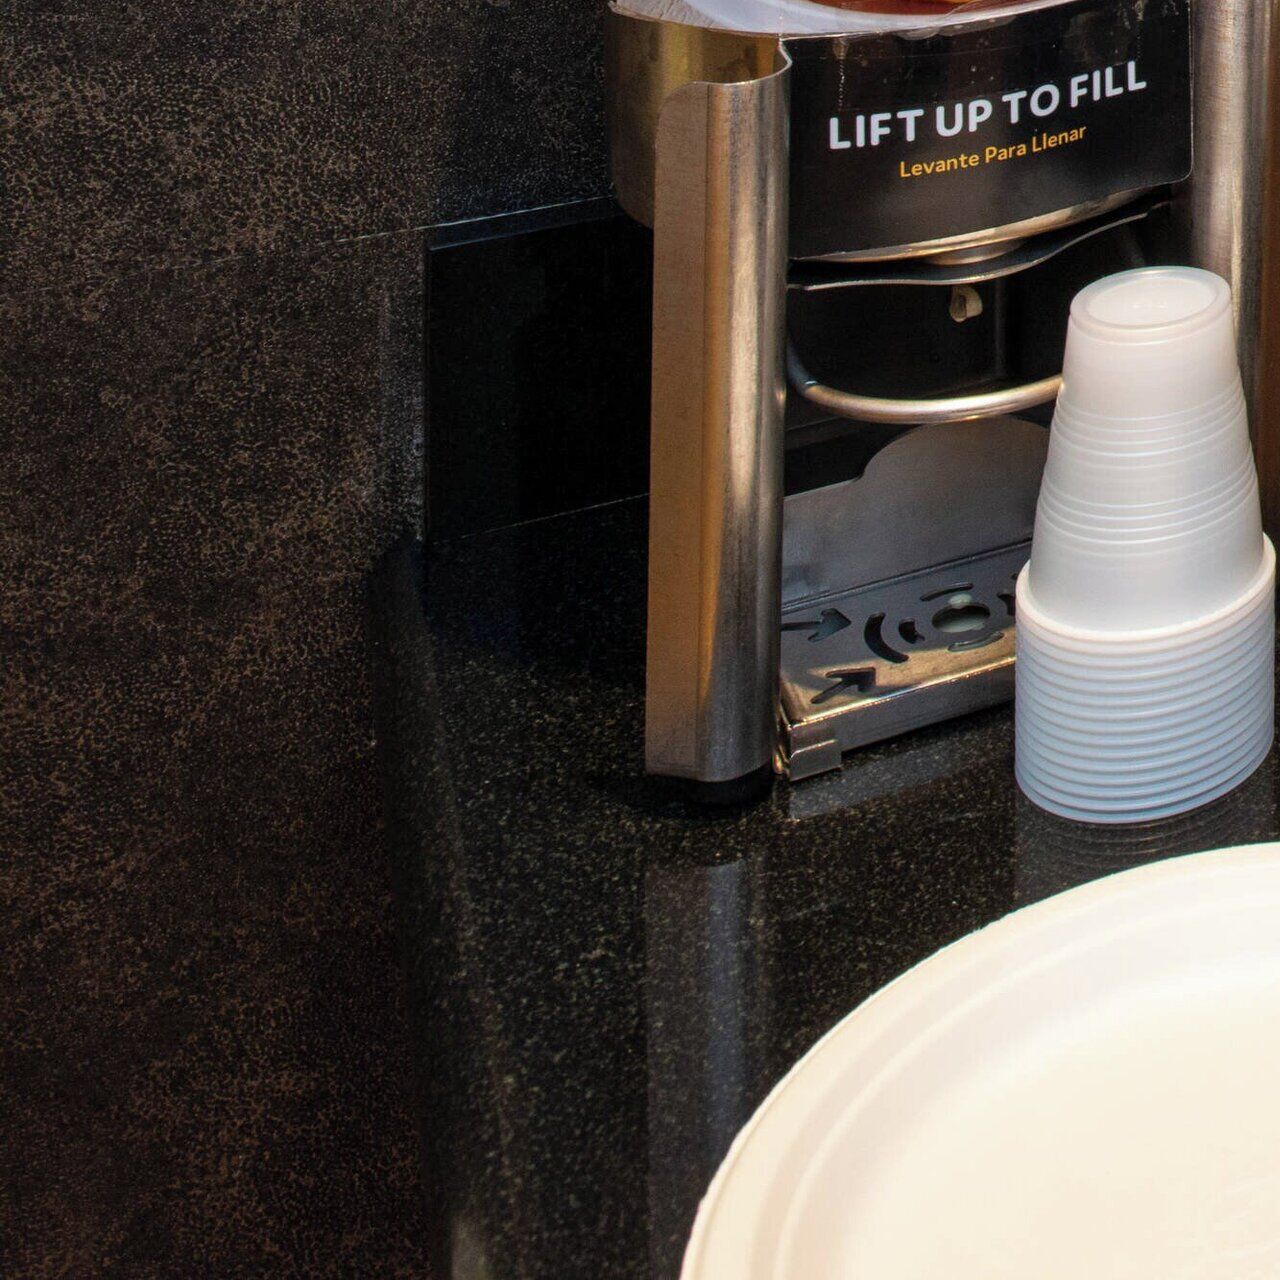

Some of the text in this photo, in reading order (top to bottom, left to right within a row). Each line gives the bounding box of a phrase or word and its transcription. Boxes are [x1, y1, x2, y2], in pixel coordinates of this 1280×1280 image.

[829, 60, 1147, 150] LIFT UP TO FILL
[900, 124, 1087, 178] Levante Para Llenar
